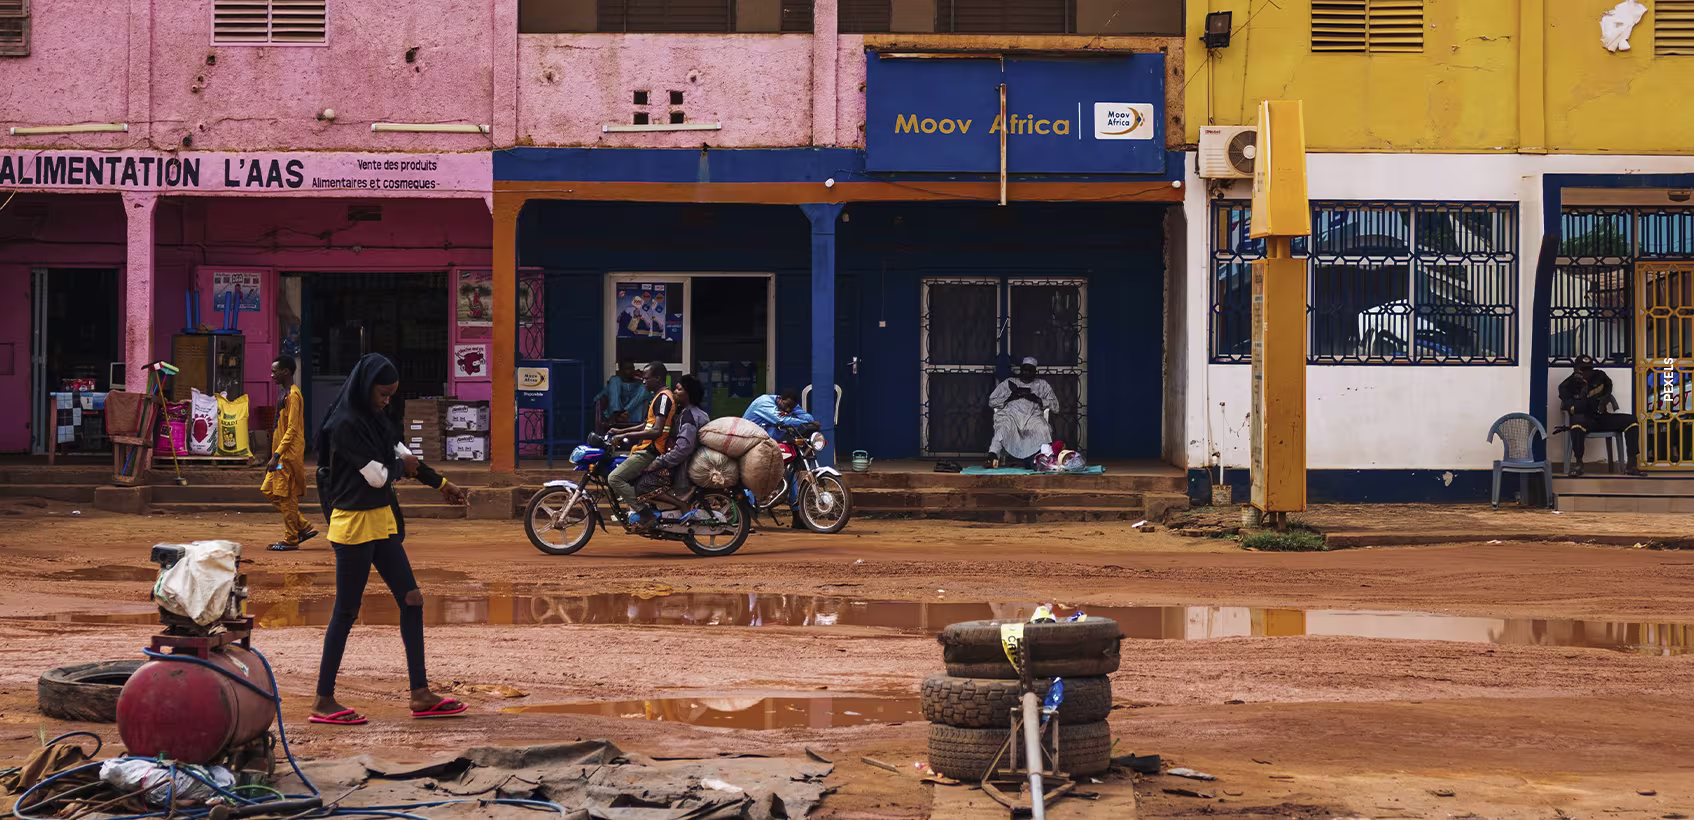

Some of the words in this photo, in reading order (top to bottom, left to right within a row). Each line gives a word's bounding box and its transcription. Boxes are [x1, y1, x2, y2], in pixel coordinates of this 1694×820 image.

[1107, 110, 1130, 119] Moov
[895, 114, 972, 134] Moov
[989, 114, 1070, 135] Africa
[1107, 118, 1130, 127] Africa
[357, 159, 382, 170] Vente
[384, 159, 399, 170] des
[401, 159, 437, 172] produits
[0, 156, 200, 187] ALIMENTATION
[224, 158, 304, 188] L'AAS
[312, 177, 368, 189] Alimentaires
[370, 178, 381, 189] et
